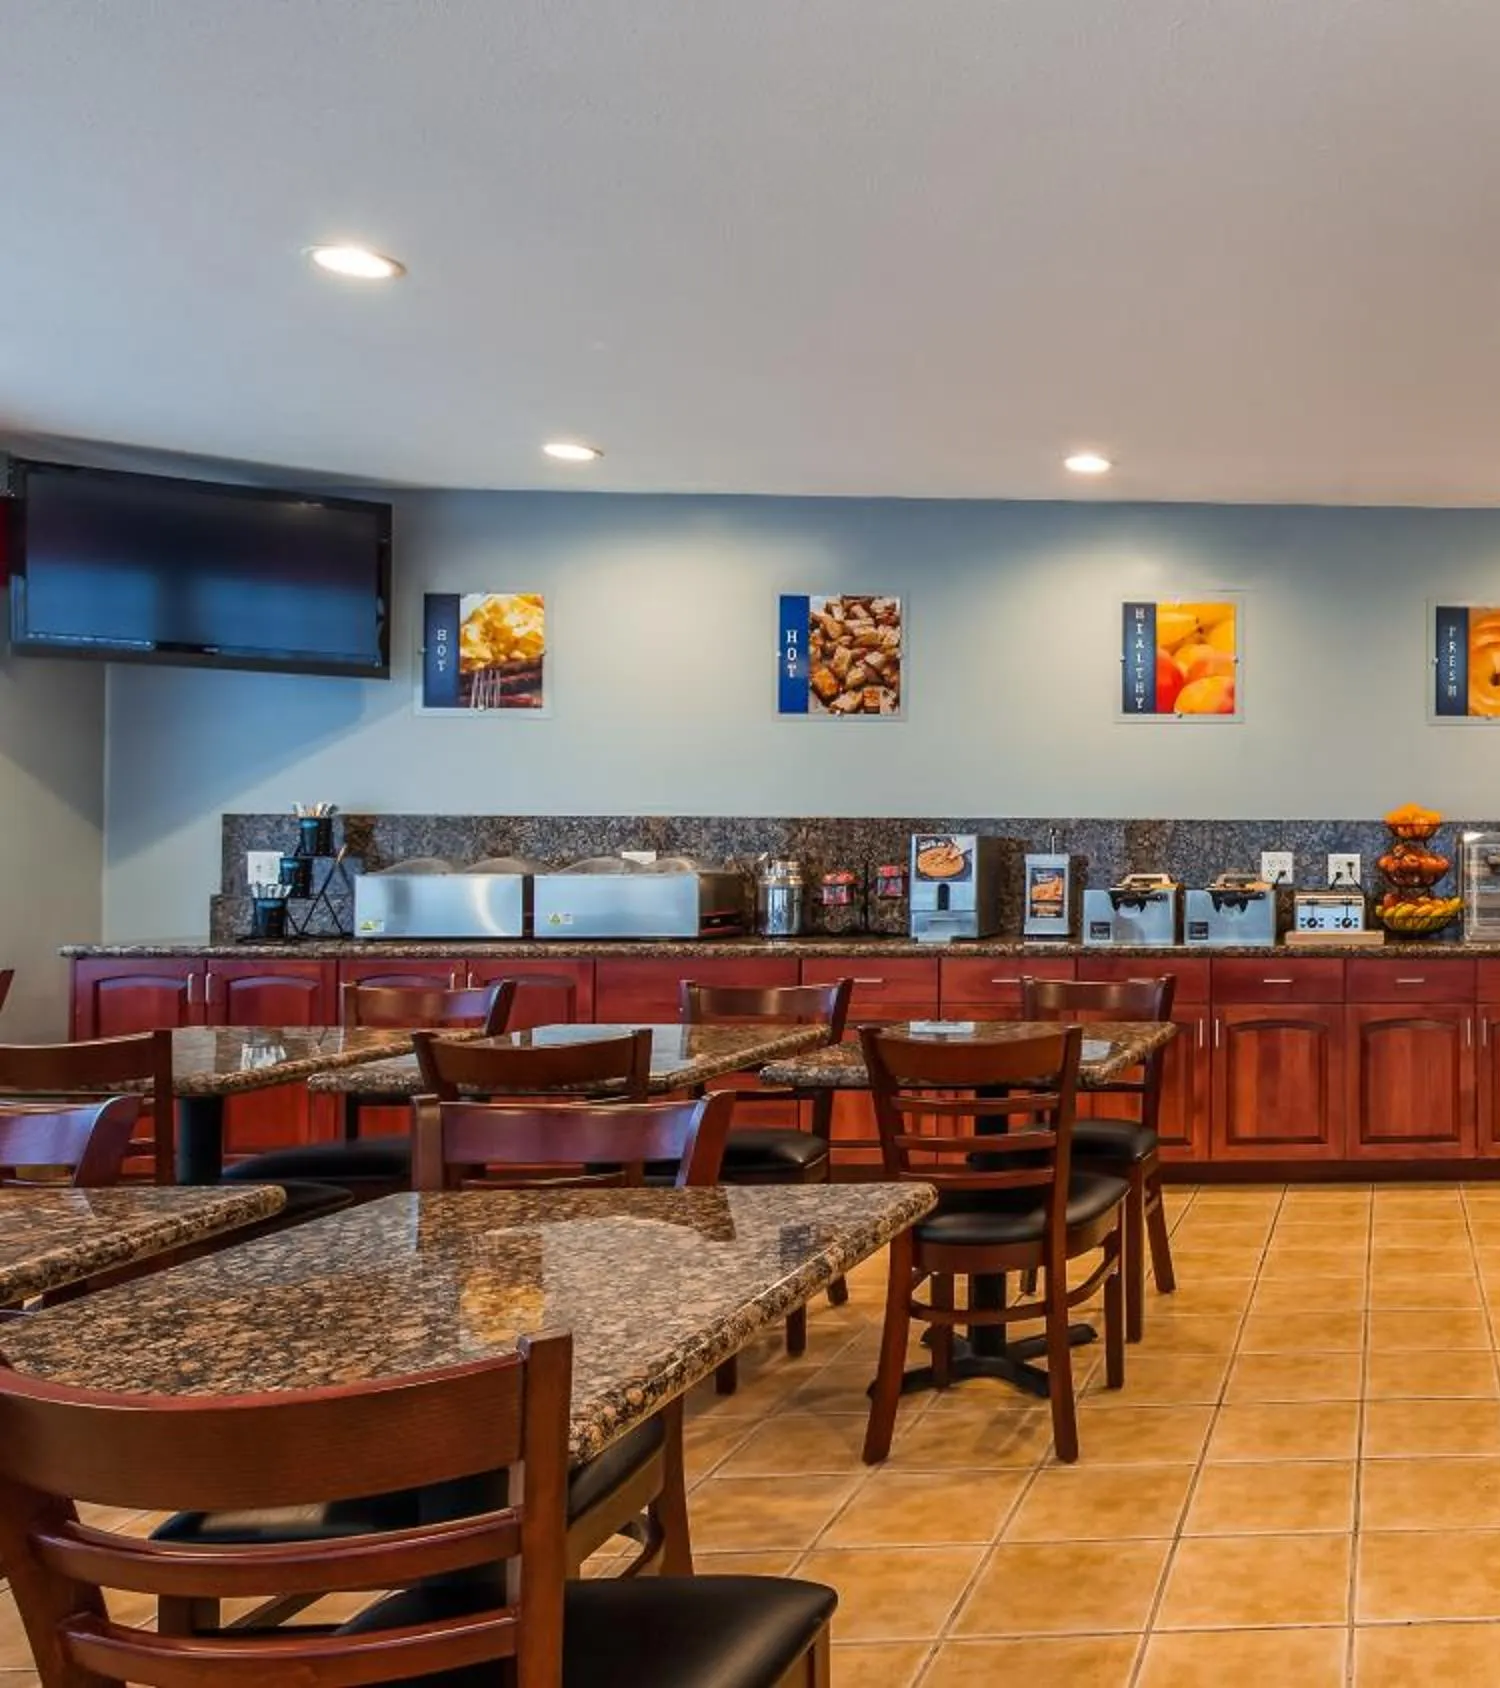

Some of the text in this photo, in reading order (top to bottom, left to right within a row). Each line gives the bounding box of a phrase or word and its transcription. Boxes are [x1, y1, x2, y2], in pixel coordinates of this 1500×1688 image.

[436, 628, 448, 673] HOT
[786, 628, 798, 679] HOT
[1135, 607, 1145, 709] HEALTHY
[1447, 625, 1457, 697] FRESH
